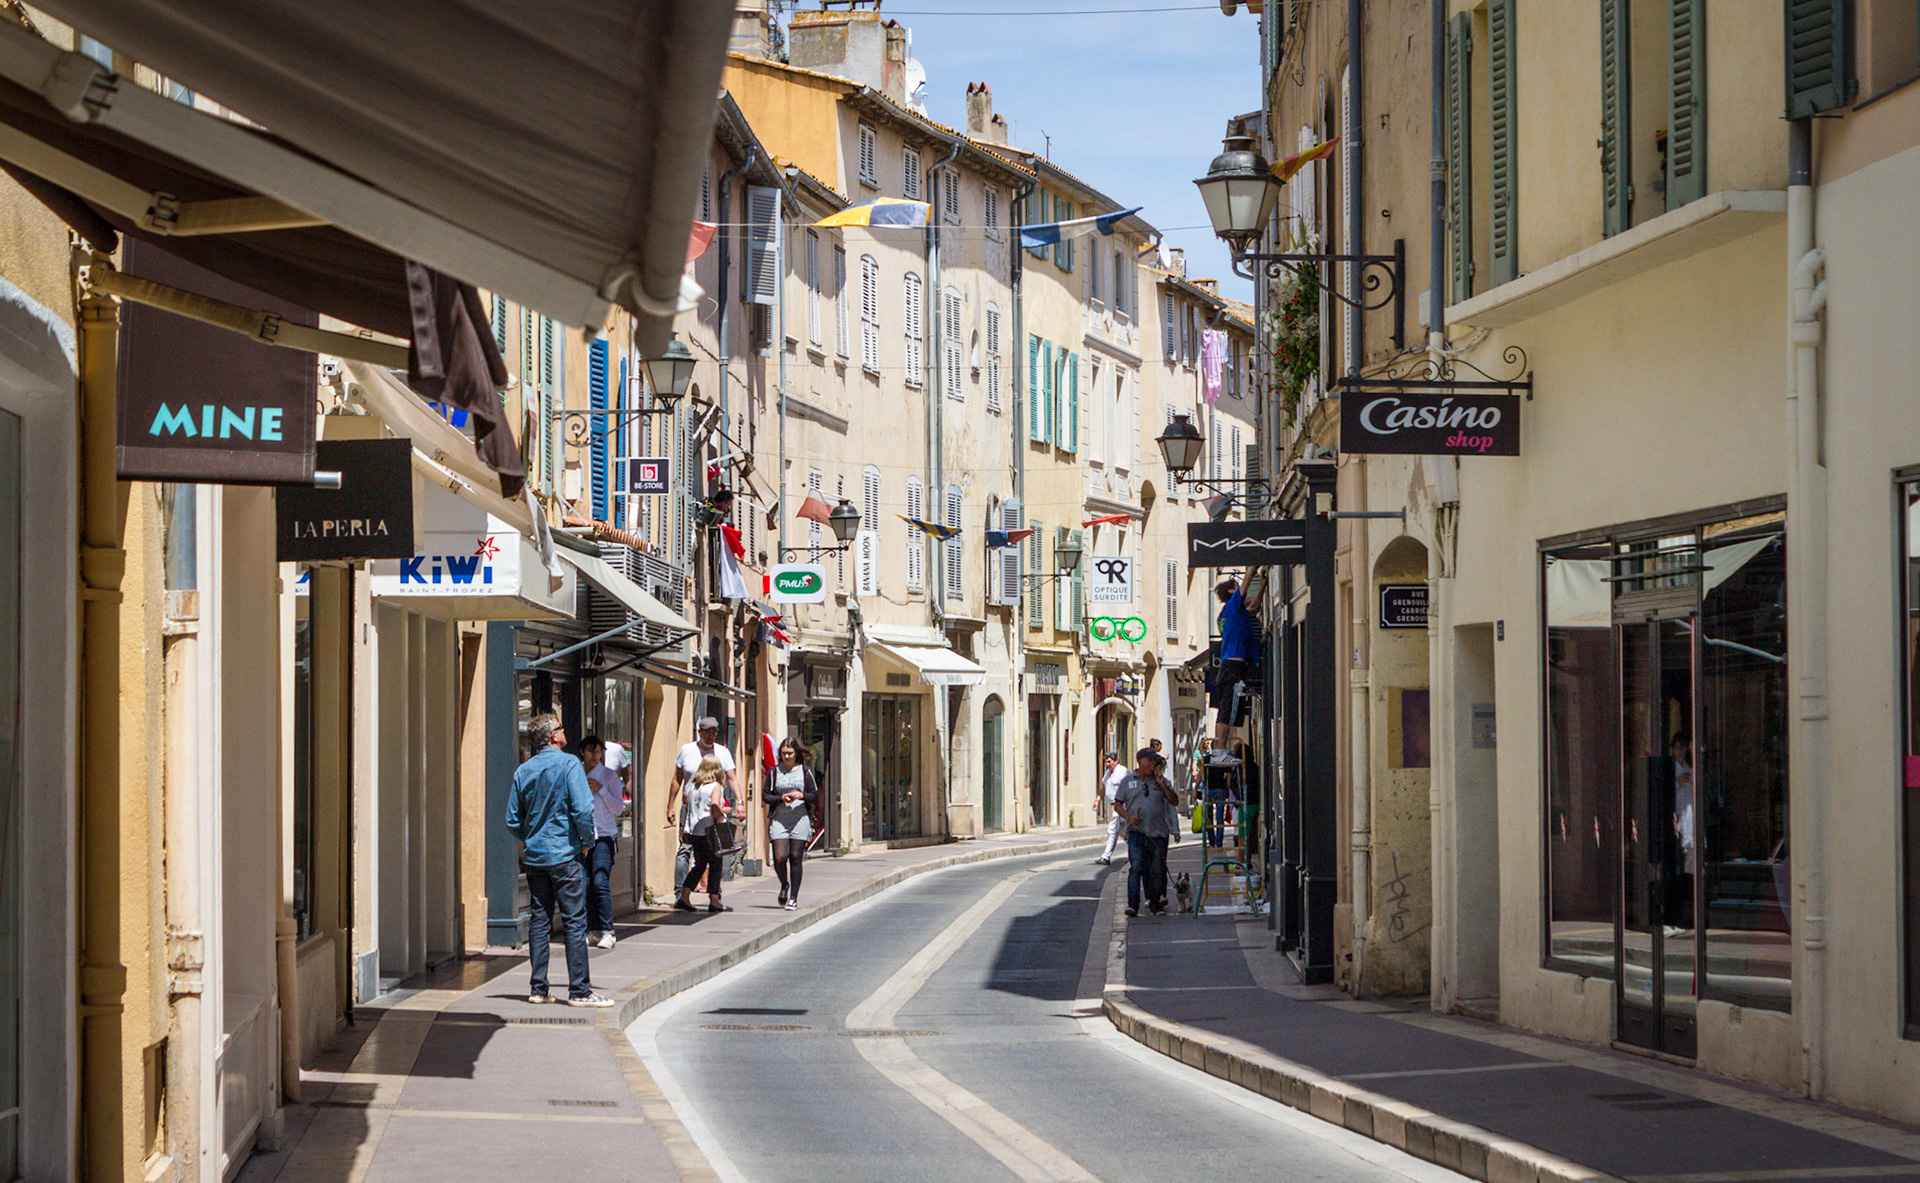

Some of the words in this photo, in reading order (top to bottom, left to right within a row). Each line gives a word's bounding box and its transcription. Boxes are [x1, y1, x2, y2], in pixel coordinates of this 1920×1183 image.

[149, 402, 283, 441] MINE
[1360, 397, 1501, 434] Casino
[1445, 430, 1494, 452] shop
[634, 482, 664, 490] BE-STORE
[294, 520, 318, 538] LA
[322, 519, 389, 538] PERLA
[862, 536, 871, 561] MOON
[779, 579, 802, 588] PMU
[862, 562, 871, 592] BANANA
[1094, 586, 1128, 594] OPTIQUE
